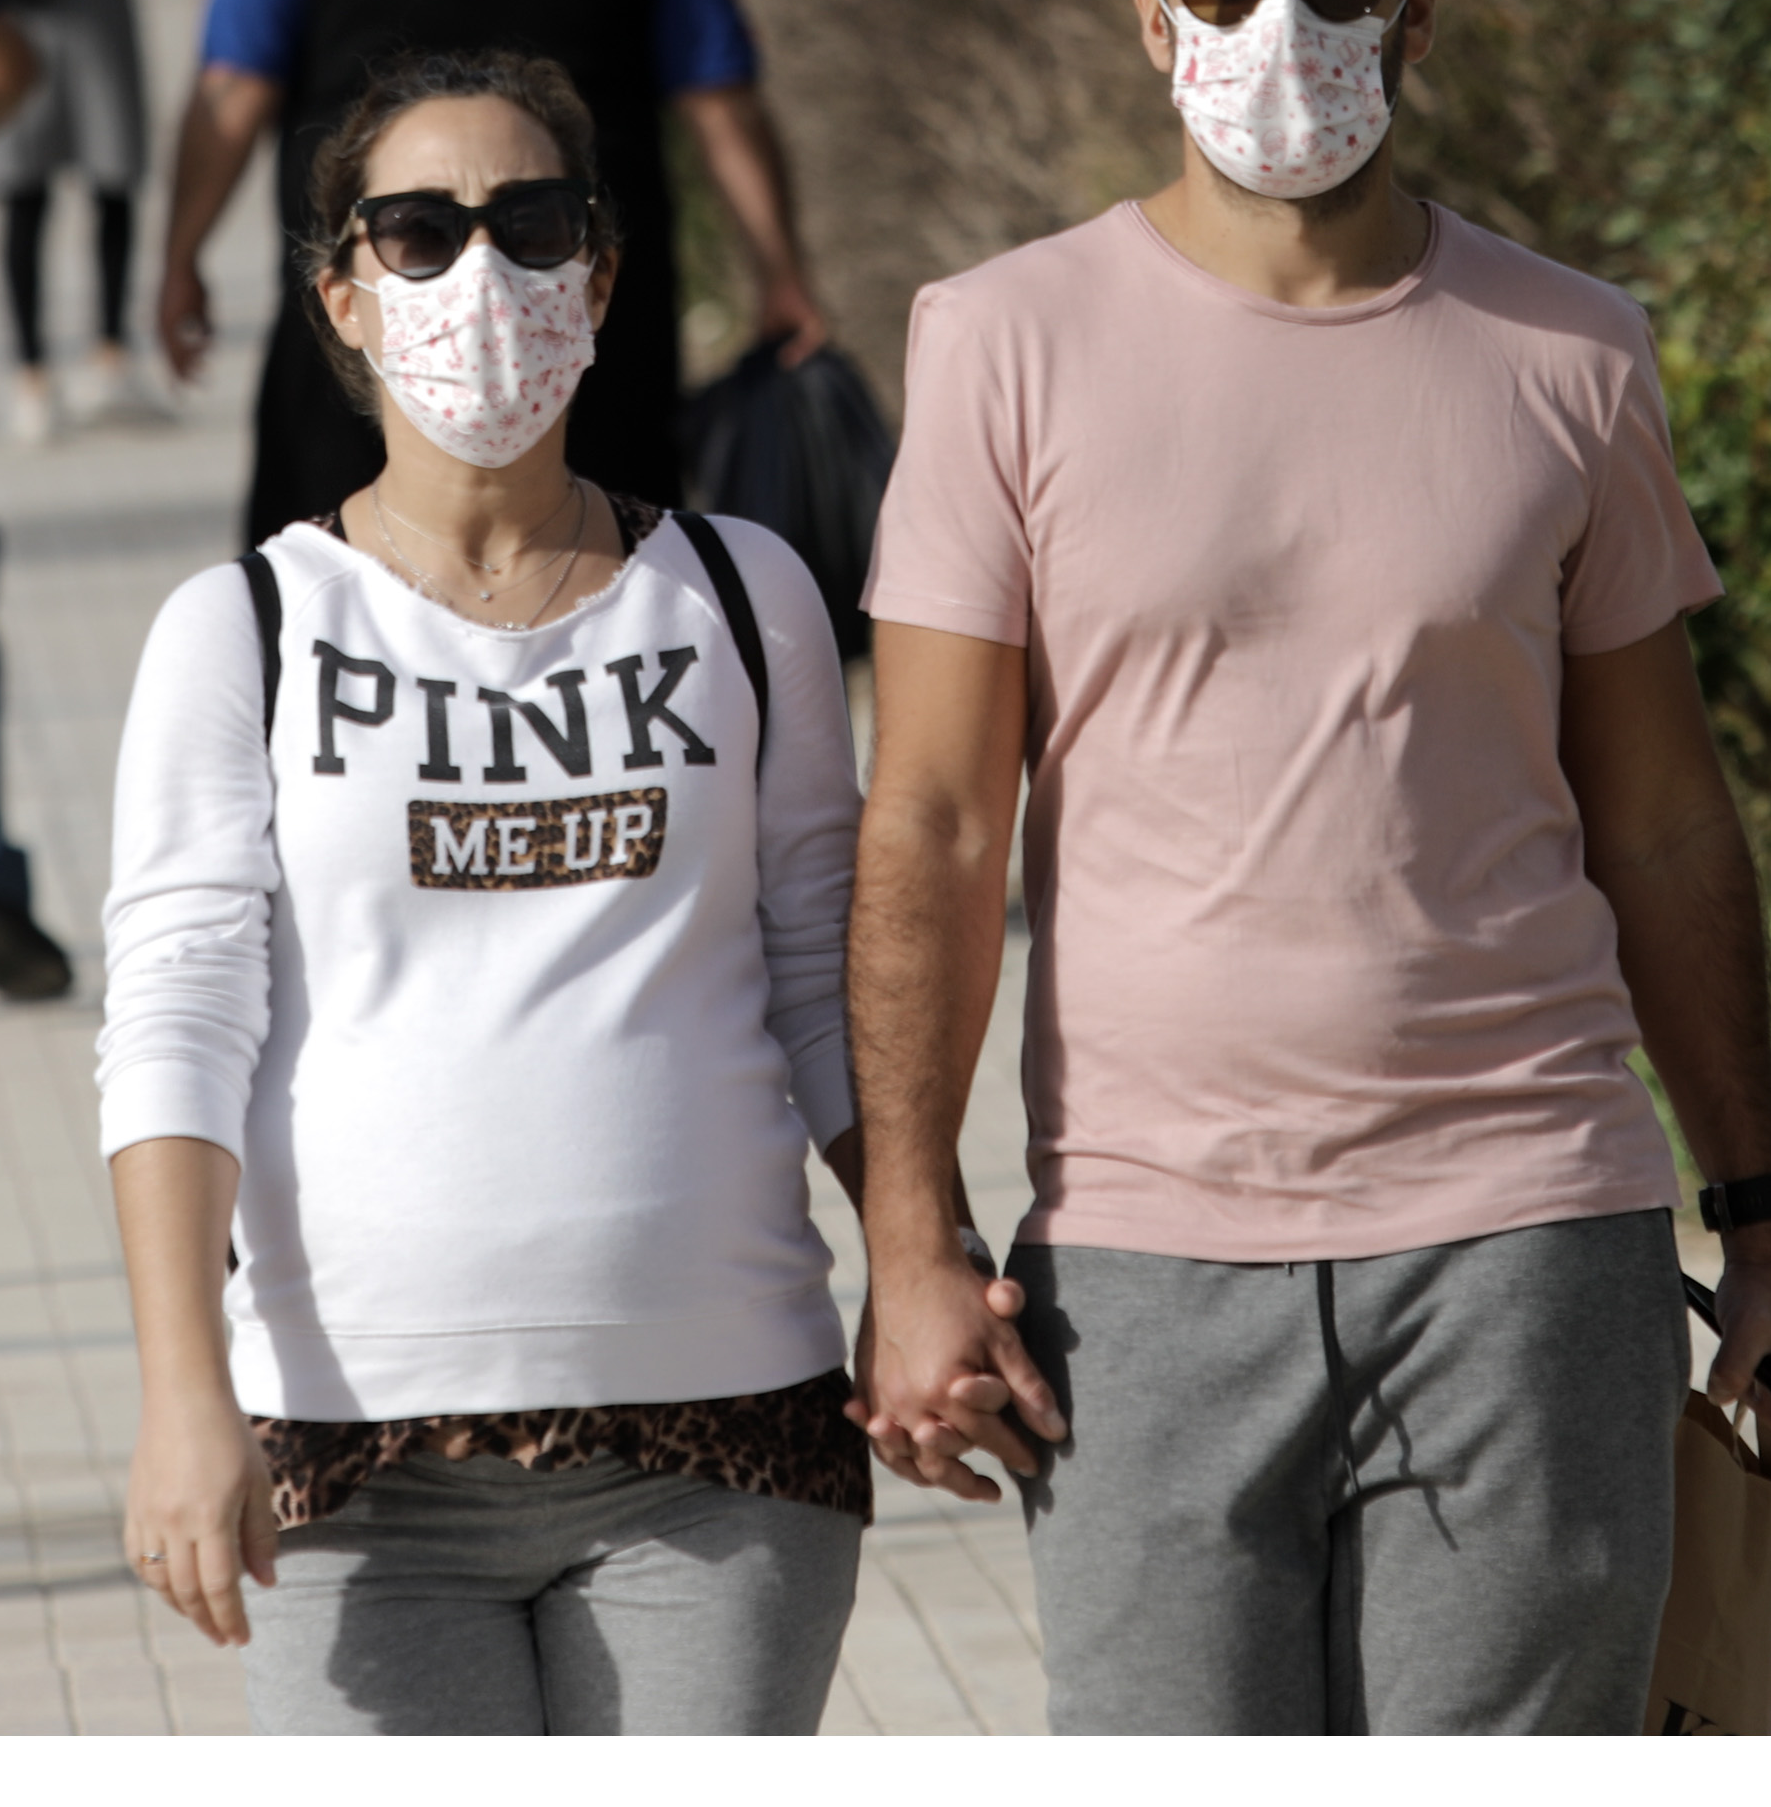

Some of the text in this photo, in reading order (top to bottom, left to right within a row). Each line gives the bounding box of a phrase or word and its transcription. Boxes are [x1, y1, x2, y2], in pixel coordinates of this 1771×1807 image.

[312, 639, 716, 784] PINK
[430, 804, 653, 877] ME UP
